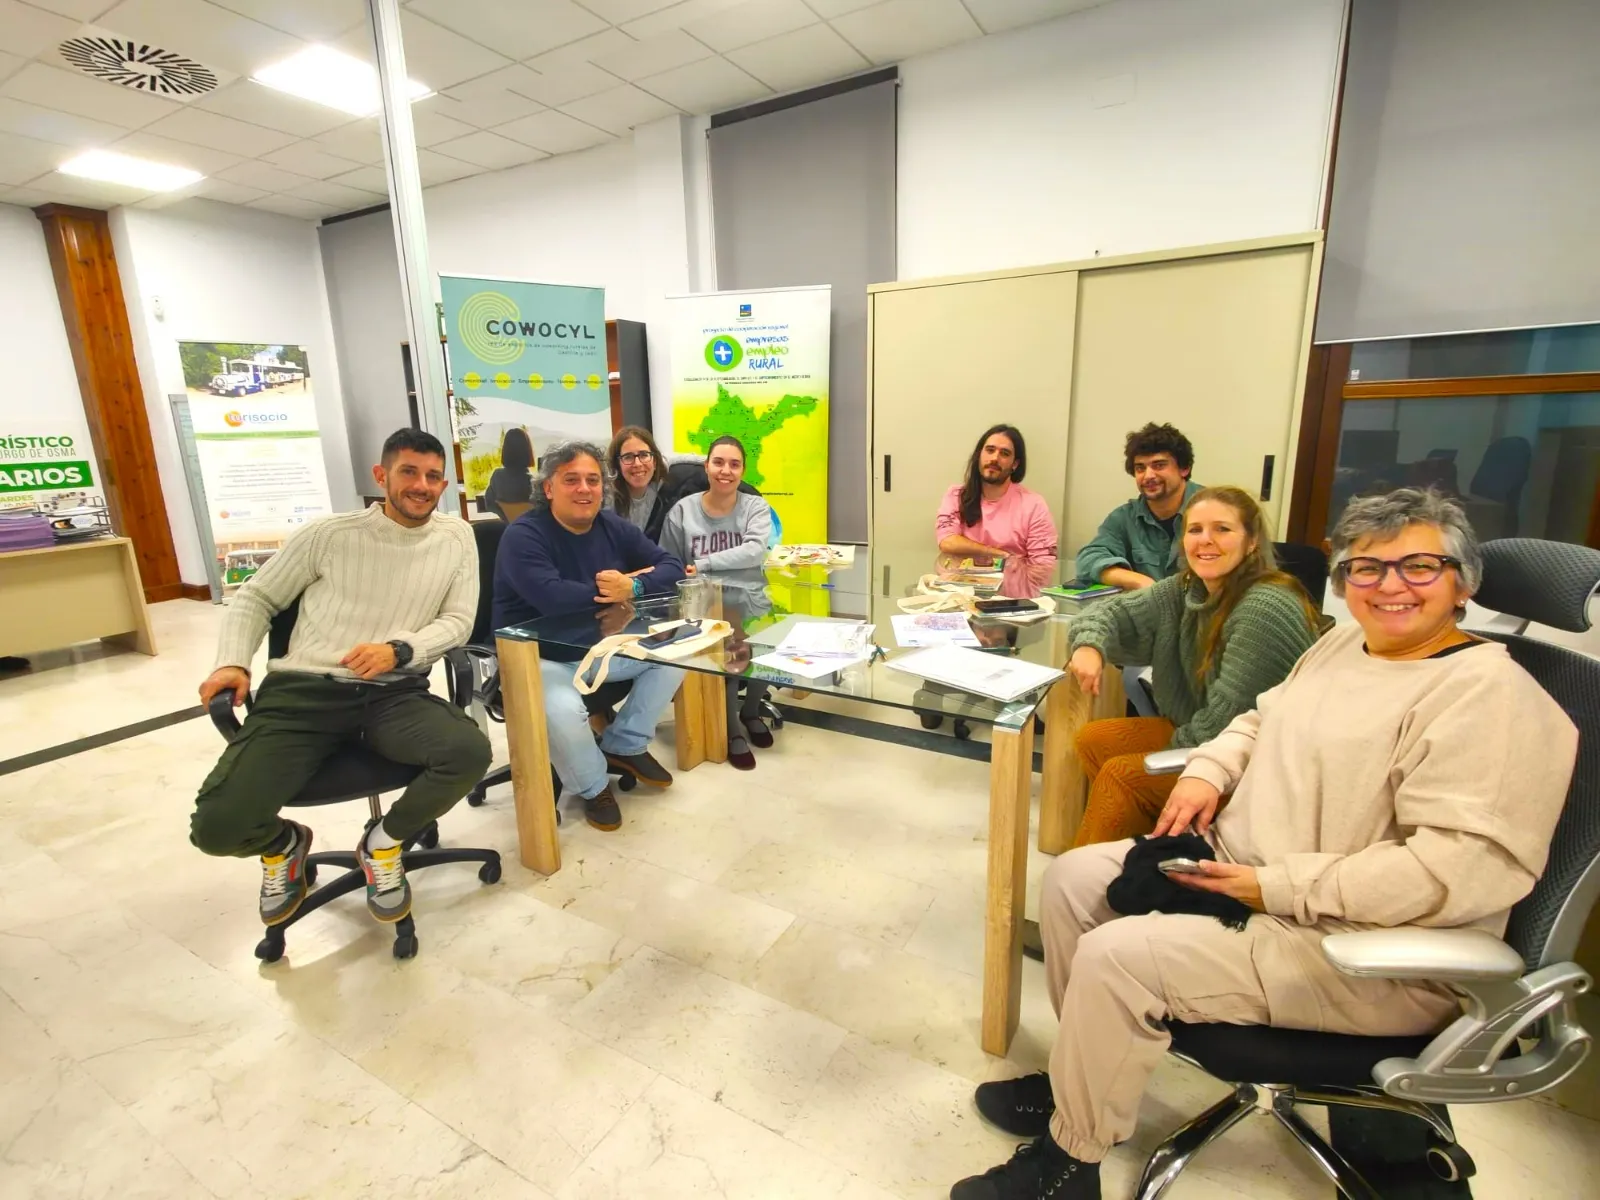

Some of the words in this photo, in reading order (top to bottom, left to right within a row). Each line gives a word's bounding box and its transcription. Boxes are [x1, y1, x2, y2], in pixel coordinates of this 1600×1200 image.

[486, 319, 595, 339] COWOCYL
[746, 335, 789, 346] empresas
[746, 344, 789, 358] empleo
[748, 357, 785, 371] RURAL
[0, 434, 73, 449] RÍSTICO
[29, 448, 43, 458] DE
[47, 447, 77, 458] OSMA
[0, 467, 83, 487] ARIOS
[691, 530, 743, 558] FLORID
